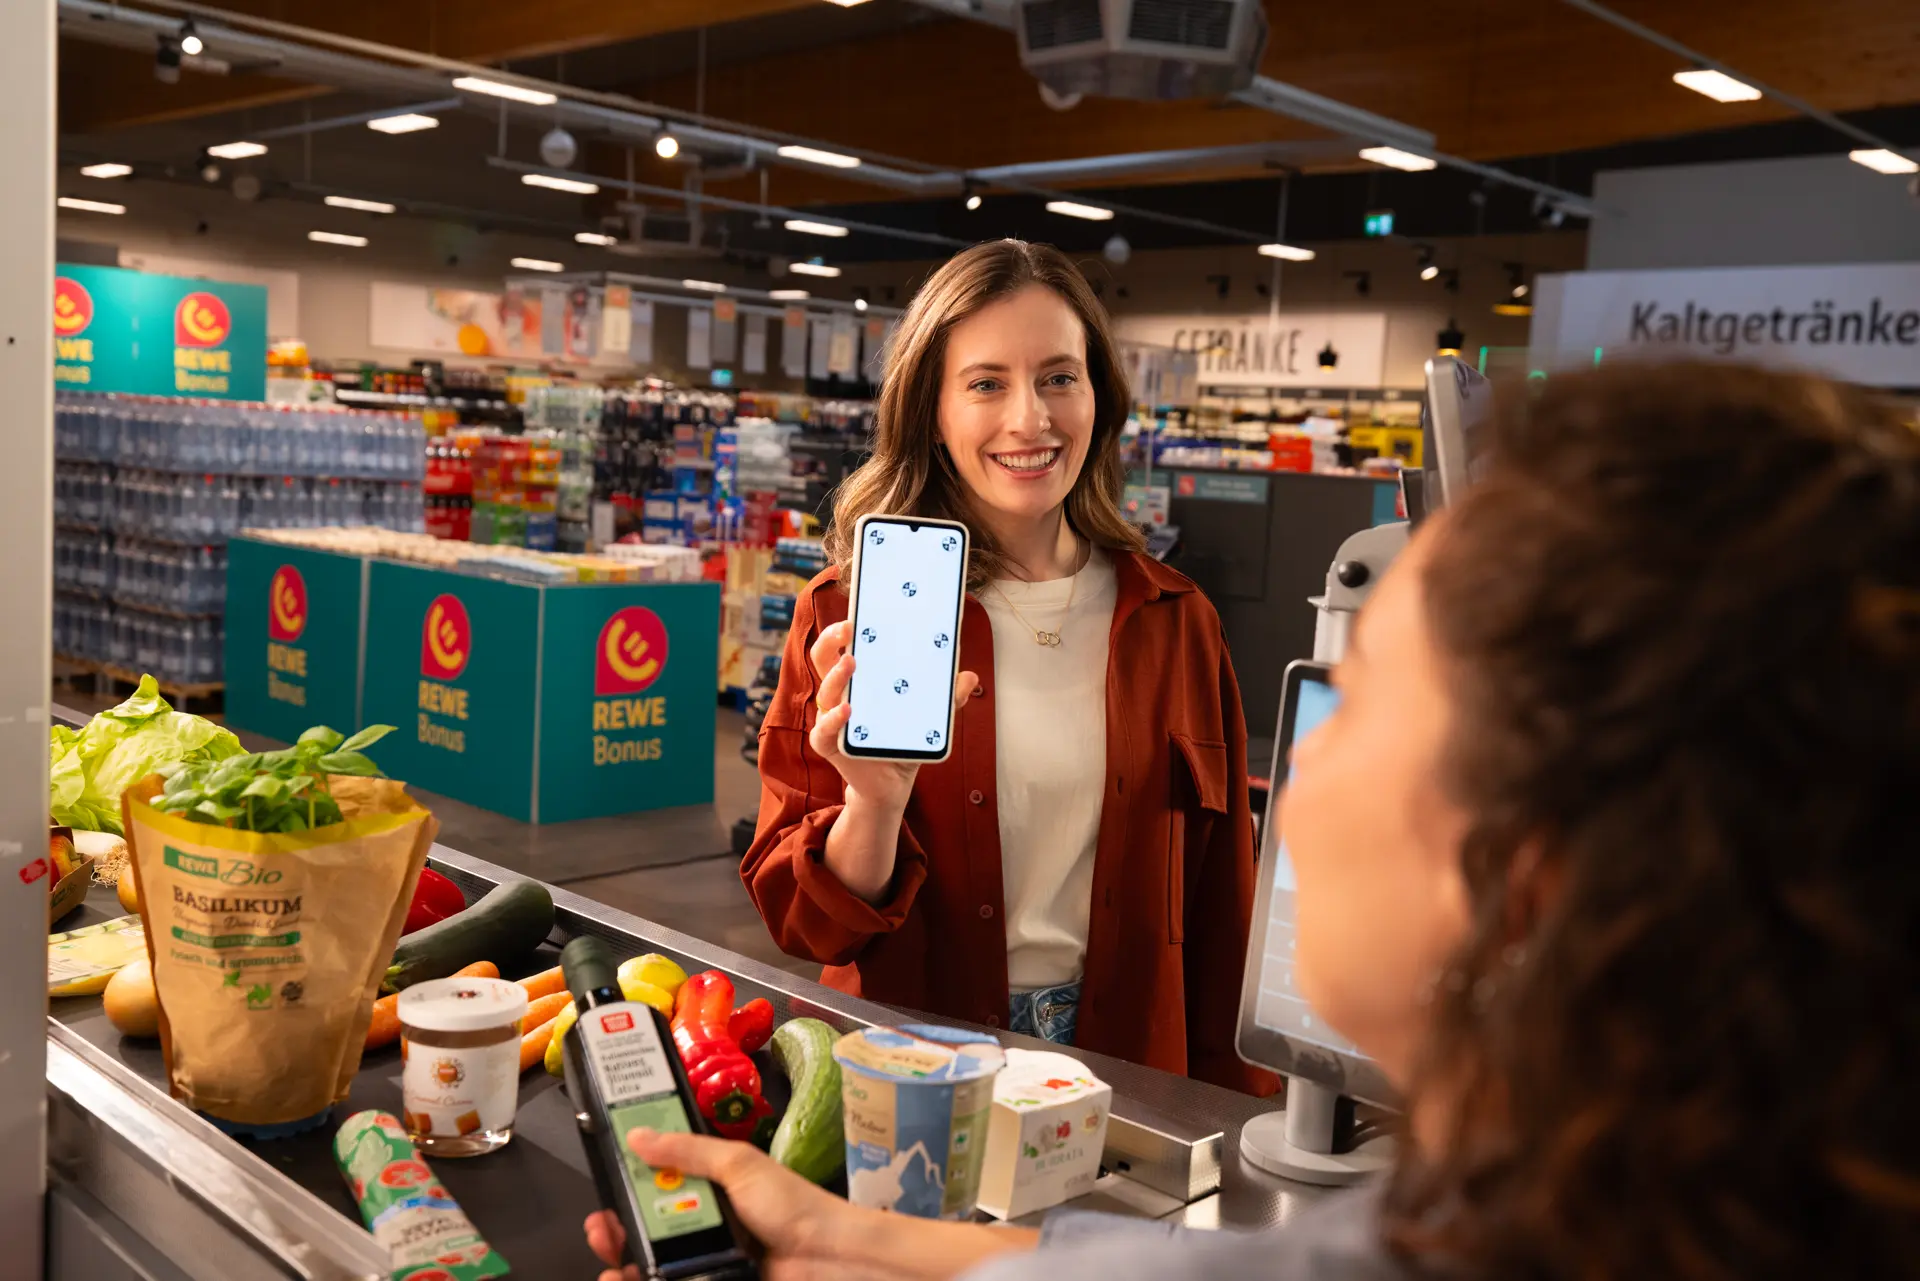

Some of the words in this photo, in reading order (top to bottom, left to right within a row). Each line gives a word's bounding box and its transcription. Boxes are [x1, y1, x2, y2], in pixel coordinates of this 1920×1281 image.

[1629, 297, 1920, 354] Kaltgetränke
[54, 338, 93, 361] WE
[54, 365, 91, 384] nus
[268, 642, 306, 677] REWE
[268, 671, 305, 707] Bonus
[418, 680, 469, 719] REWE
[593, 696, 666, 731] REWE
[418, 713, 464, 752] Bonus
[593, 735, 662, 766] Bonus
[219, 859, 283, 886] Bio
[172, 885, 303, 915] BASILIKUM
